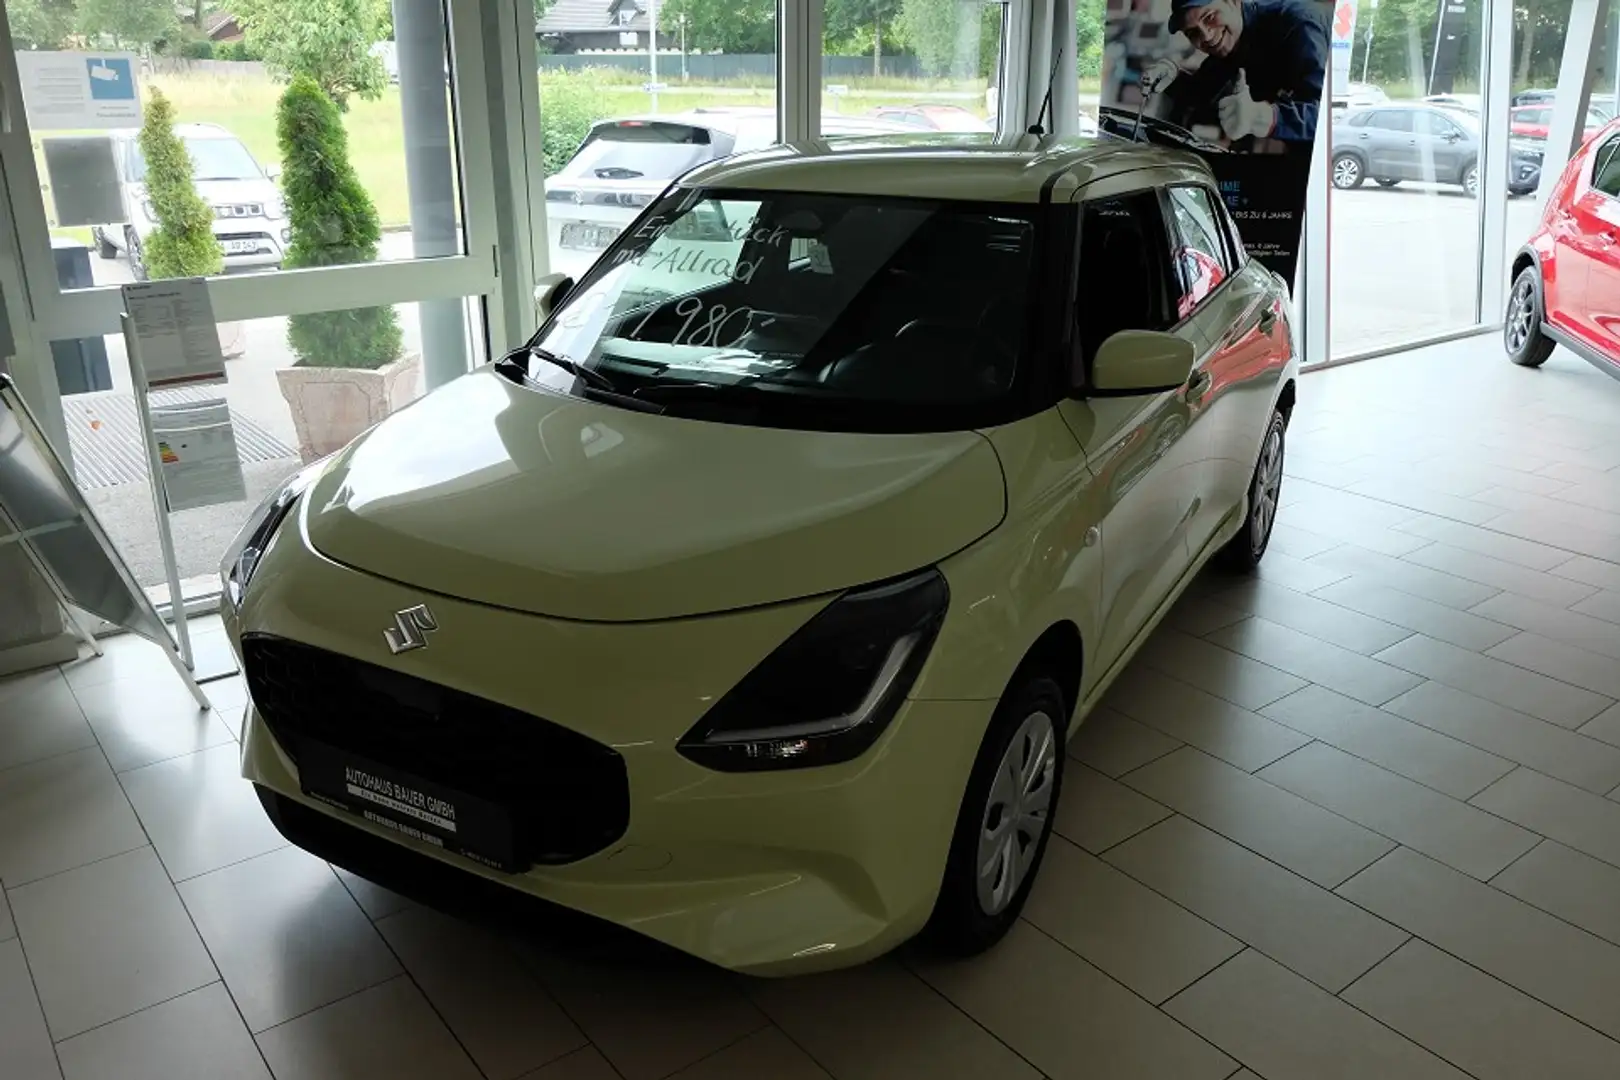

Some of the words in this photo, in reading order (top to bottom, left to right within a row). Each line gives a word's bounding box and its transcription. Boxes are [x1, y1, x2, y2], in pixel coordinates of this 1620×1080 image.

[652, 245, 765, 285] Allrad
[345, 765, 394, 797] AUTOHAUS
[394, 783, 427, 809] BAUER
